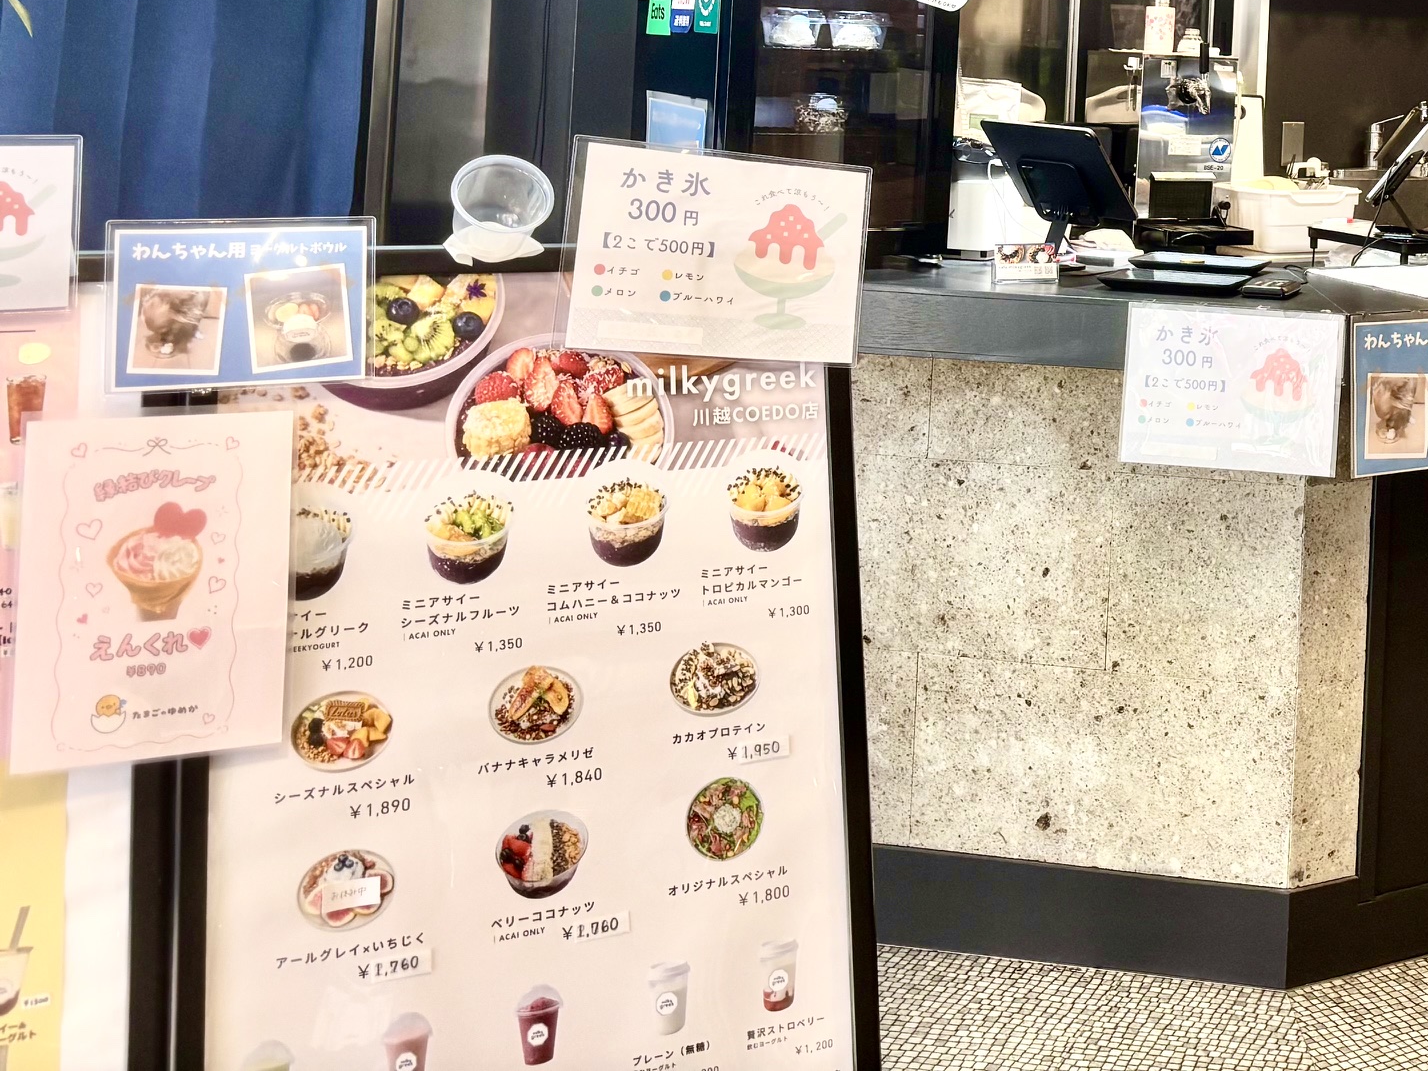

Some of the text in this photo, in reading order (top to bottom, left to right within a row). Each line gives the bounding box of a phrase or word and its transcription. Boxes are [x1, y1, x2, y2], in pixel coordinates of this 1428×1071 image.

[650, 3, 665, 20] Eats
[620, 167, 711, 197] かき氷
[627, 198, 699, 226] 300円
[132, 241, 246, 261] わんちゃん用
[607, 266, 705, 281] イチゴ レモン
[604, 287, 735, 306] メロン ブルーハワイ
[1155, 324, 1218, 345] かき氷
[626, 365, 817, 402] milkygreek
[693, 401, 819, 427] 川越COEDO店
[1147, 400, 1219, 411] イチゴ レモン
[1147, 417, 1242, 429] メロン ブルーハワイ
[94, 468, 216, 503] 縁結びクレープ
[701, 564, 768, 579] ミニアサイー
[547, 579, 620, 595] ミニアサイー
[702, 577, 802, 596] トロピカルマンゴー
[402, 594, 481, 610] ミニアサイー
[707, 596, 748, 607] ACAI ONLY
[293, 610, 327, 622] イー
[401, 605, 521, 628] シーズナルフルーツ
[554, 611, 598, 624] ACAI ONLY
[768, 605, 810, 620] ¥1,300
[408, 628, 456, 640] ACAI ONLY
[617, 621, 662, 636] ¥1,350
[89, 631, 189, 662] えんくれ
[474, 637, 523, 653] ¥1,350
[126, 662, 167, 678] ¥890
[322, 655, 374, 672] ¥1,200
[672, 722, 766, 745] カカオプロテイン
[478, 747, 594, 775] バナナキャラメリゼ
[546, 767, 602, 788] ¥1,840
[274, 773, 415, 805] シーズナルスペシャル
[350, 797, 411, 819] ¥1,890
[668, 865, 788, 896] オリジナルスペシャル
[739, 885, 790, 906] ¥1,800
[491, 900, 595, 929] ベリーココナッツ
[499, 926, 546, 942] ACAI ONLY
[747, 1017, 825, 1041] 贅沢ストロベリー
